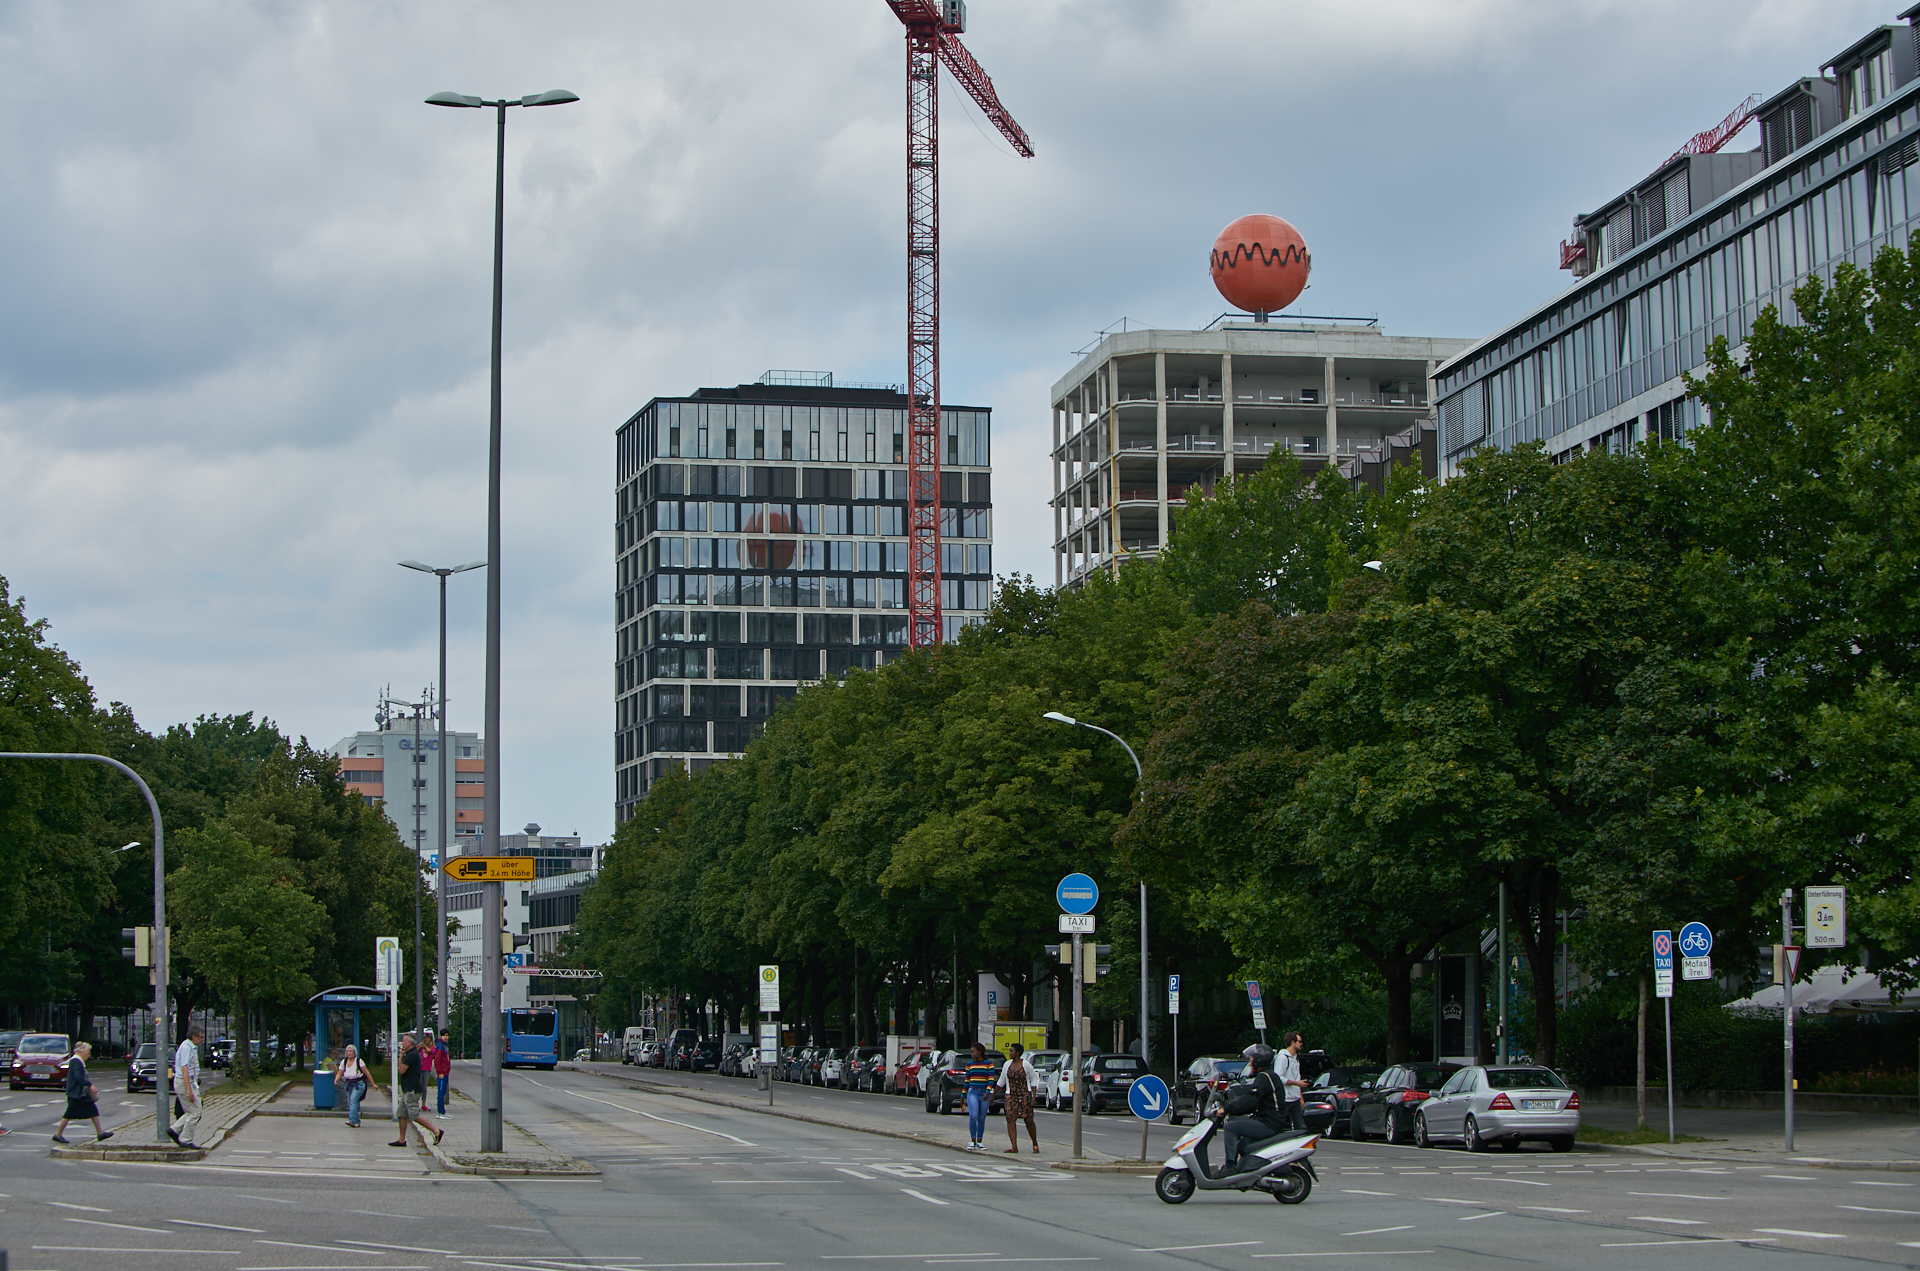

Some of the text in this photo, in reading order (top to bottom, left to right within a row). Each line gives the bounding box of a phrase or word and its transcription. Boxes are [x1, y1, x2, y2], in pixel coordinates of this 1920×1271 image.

[511, 869, 531, 877] Höhe
[1656, 958, 1671, 967] TAXI
[1690, 968, 1704, 976] frei
[1171, 978, 1177, 990] P
[864, 1163, 1077, 1179] BUS
